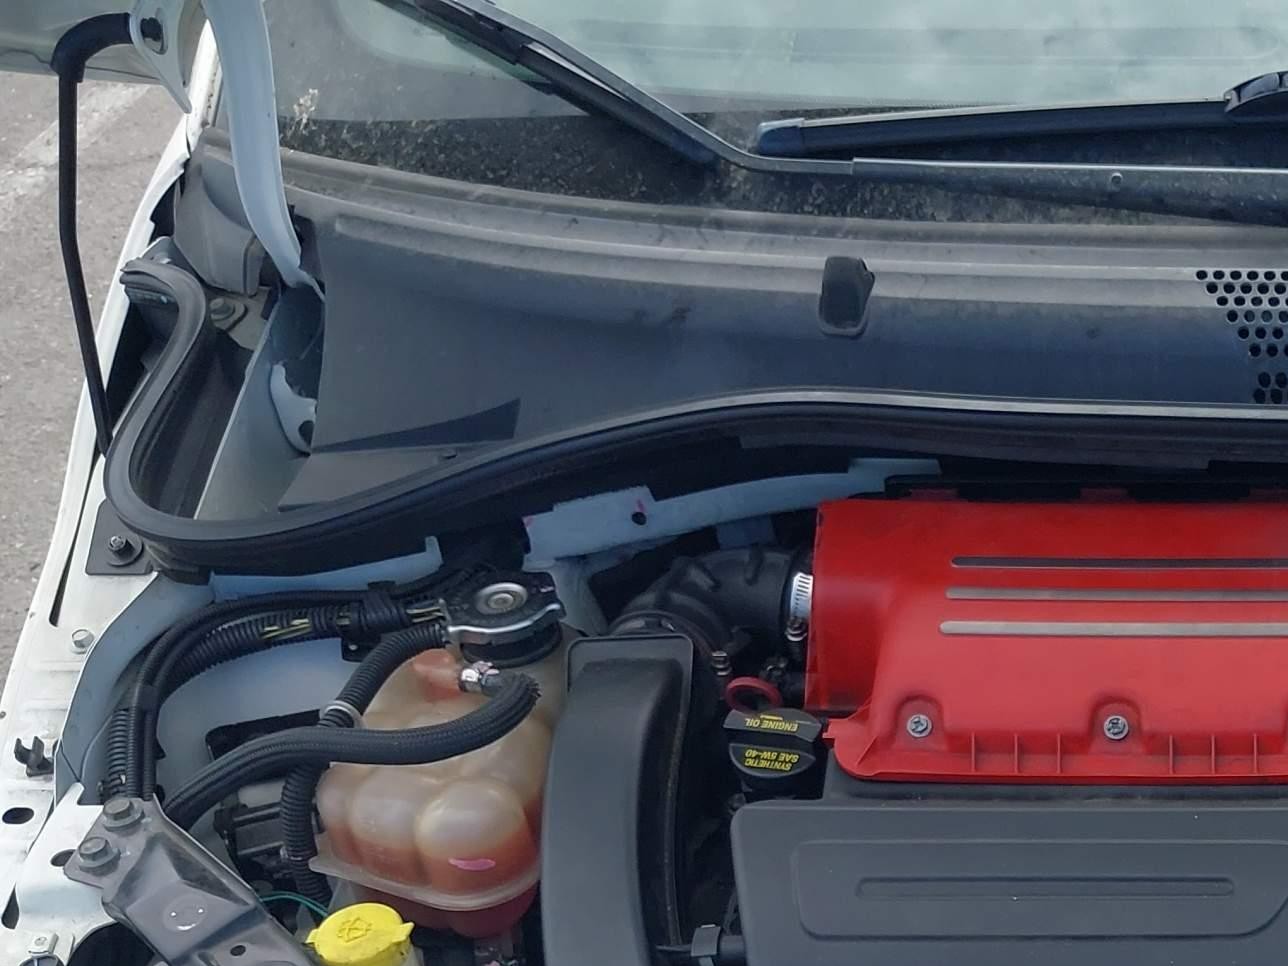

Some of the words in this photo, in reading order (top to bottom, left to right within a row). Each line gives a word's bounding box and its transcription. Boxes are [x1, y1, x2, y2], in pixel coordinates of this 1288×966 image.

[744, 718, 760, 727] OIL
[760, 718, 799, 732] ENGINE
[744, 748, 778, 760] 5W-40
[779, 752, 800, 763] SAE
[744, 758, 793, 771] SYNTHETIC
